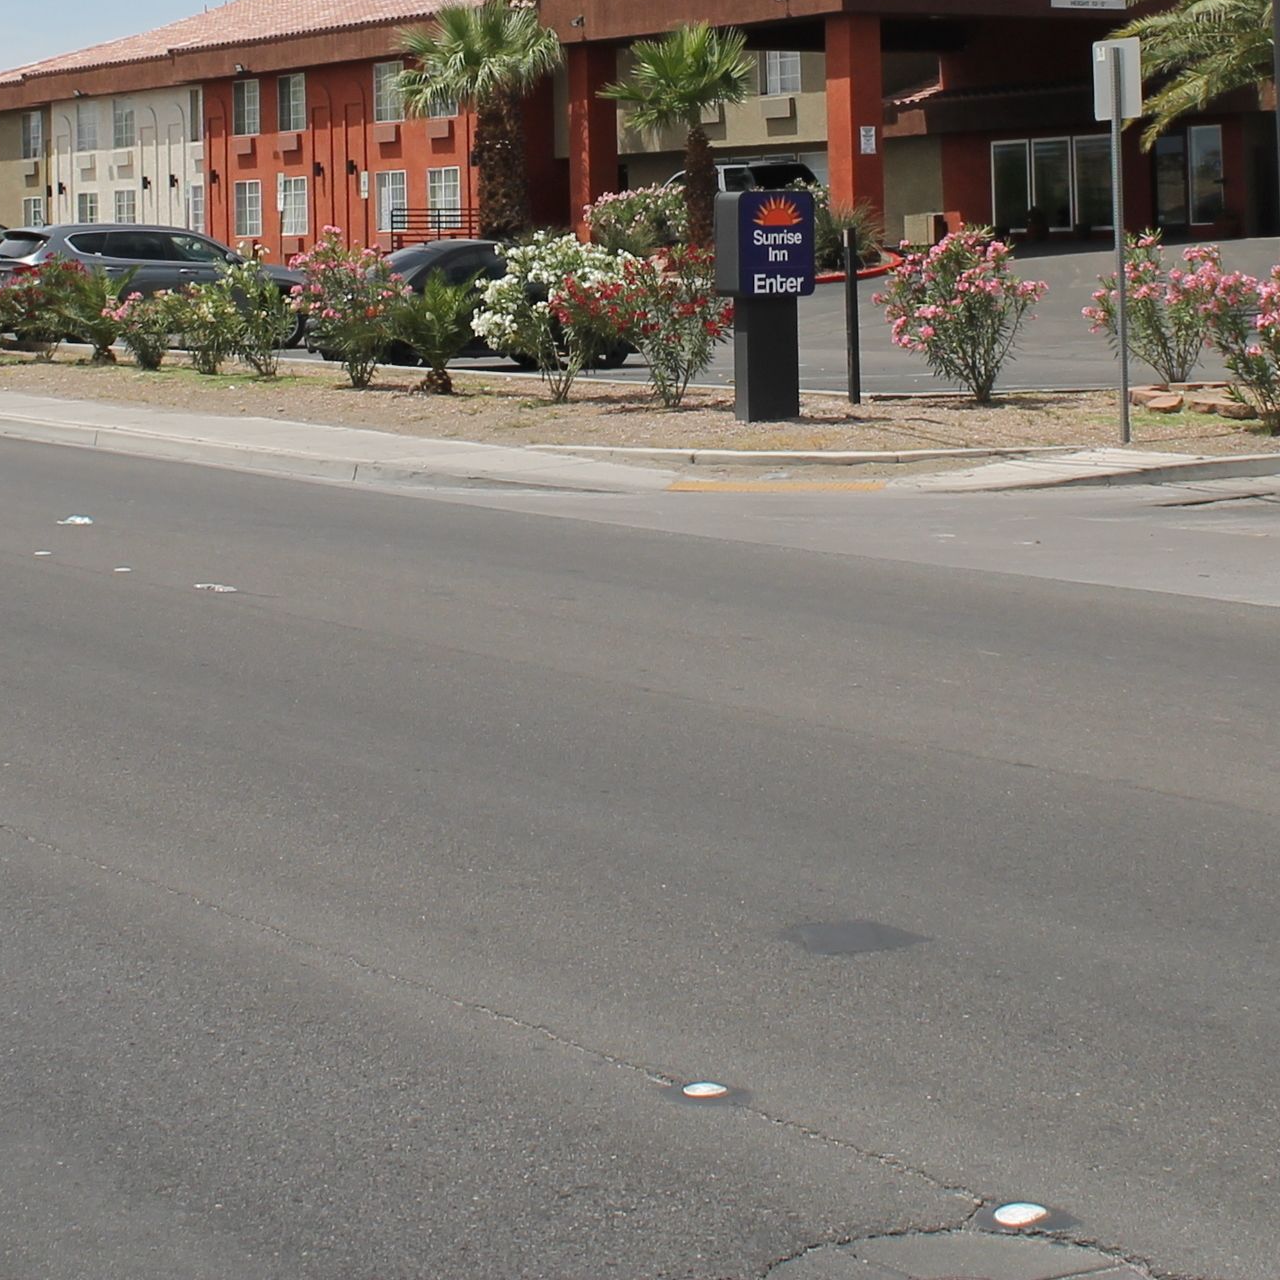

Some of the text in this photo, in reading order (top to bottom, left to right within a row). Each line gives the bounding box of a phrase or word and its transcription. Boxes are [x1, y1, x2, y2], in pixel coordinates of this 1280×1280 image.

[753, 229, 802, 245] Sunrise
[768, 246, 788, 261] Inn
[754, 273, 804, 293] Enter
